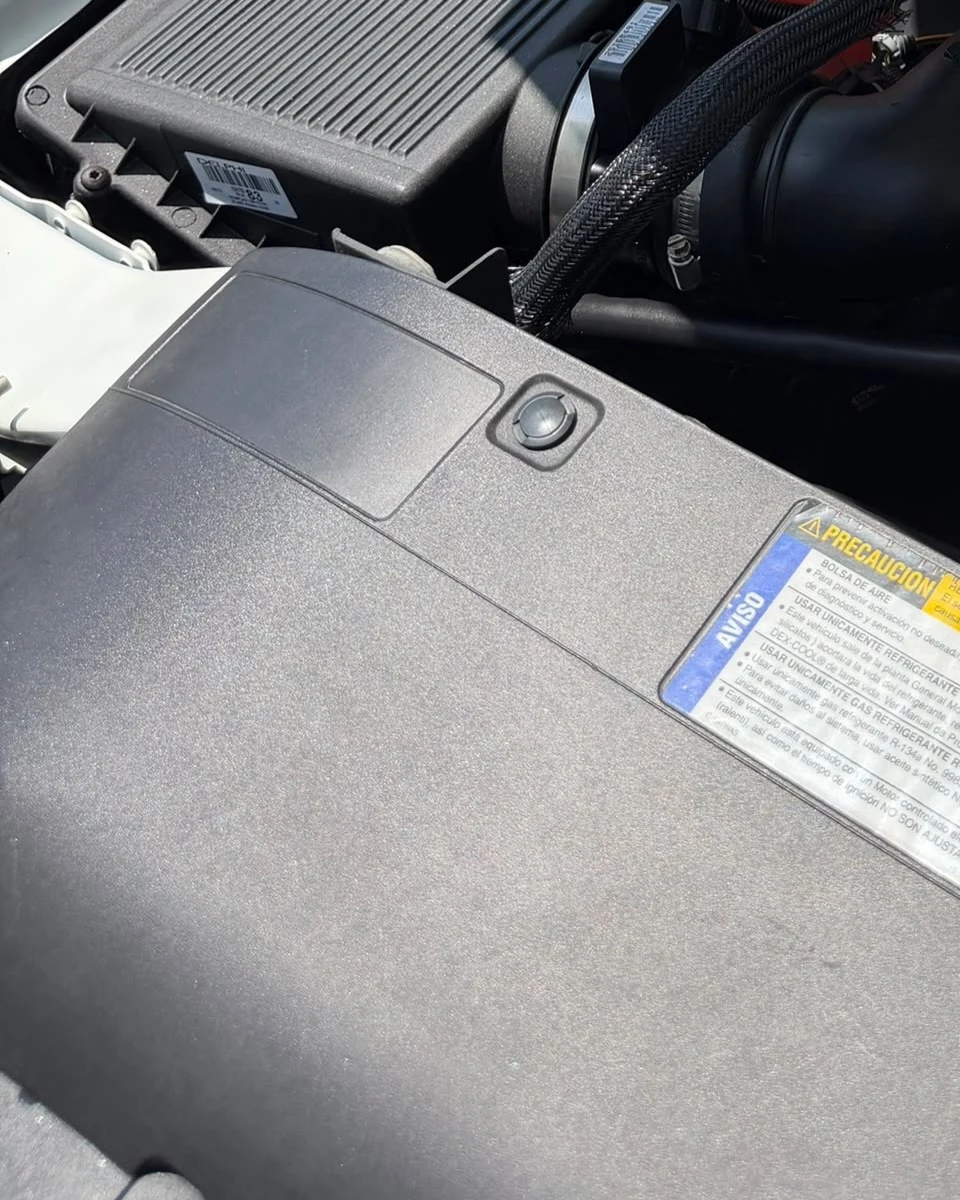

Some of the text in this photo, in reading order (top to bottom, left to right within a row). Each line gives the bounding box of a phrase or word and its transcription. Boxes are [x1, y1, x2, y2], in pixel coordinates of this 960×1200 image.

[245, 188, 264, 202] 83
[819, 559, 892, 604] BOLSA DE AIRE
[820, 524, 936, 599] PRECAUCION
[715, 592, 764, 649] AVISO
[812, 569, 833, 586] Para
[831, 582, 867, 605] prevenir
[866, 602, 910, 630] activación
[909, 627, 923, 638] no
[816, 587, 904, 643] diagnóstico servicio.
[777, 618, 811, 642] silicatos
[861, 668, 882, 684] vida
[881, 678, 898, 693] del
[785, 606, 803, 621] Este
[840, 640, 860, 655] sale
[860, 650, 873, 662] de
[881, 665, 910, 684] planta
[909, 679, 947, 706] General
[792, 595, 821, 616] USAR
[883, 647, 960, 696] REFRIGERANTE
[741, 664, 764, 682] Para
[763, 679, 788, 697] evitar
[787, 692, 816, 714] daños
[862, 739, 884, 756] usar
[883, 752, 911, 773] aceite
[750, 653, 772, 671] Usar
[771, 666, 821, 701] únicamente
[819, 697, 838, 711] gas
[837, 708, 889, 742] refrigerante
[889, 737, 922, 762] R-134a
[922, 757, 939, 773] No.
[758, 642, 788, 663] USAR
[849, 696, 873, 715] GAS
[872, 710, 950, 762] REFRIGERANTE
[837, 668, 934, 730] larga Ver Manual
[723, 689, 744, 707] Este
[800, 738, 841, 767] equipado
[872, 781, 899, 803] Motor
[898, 799, 950, 834] controlado
[765, 733, 790, 752] como
[799, 752, 832, 778] tiempo
[896, 813, 922, 833] SON
